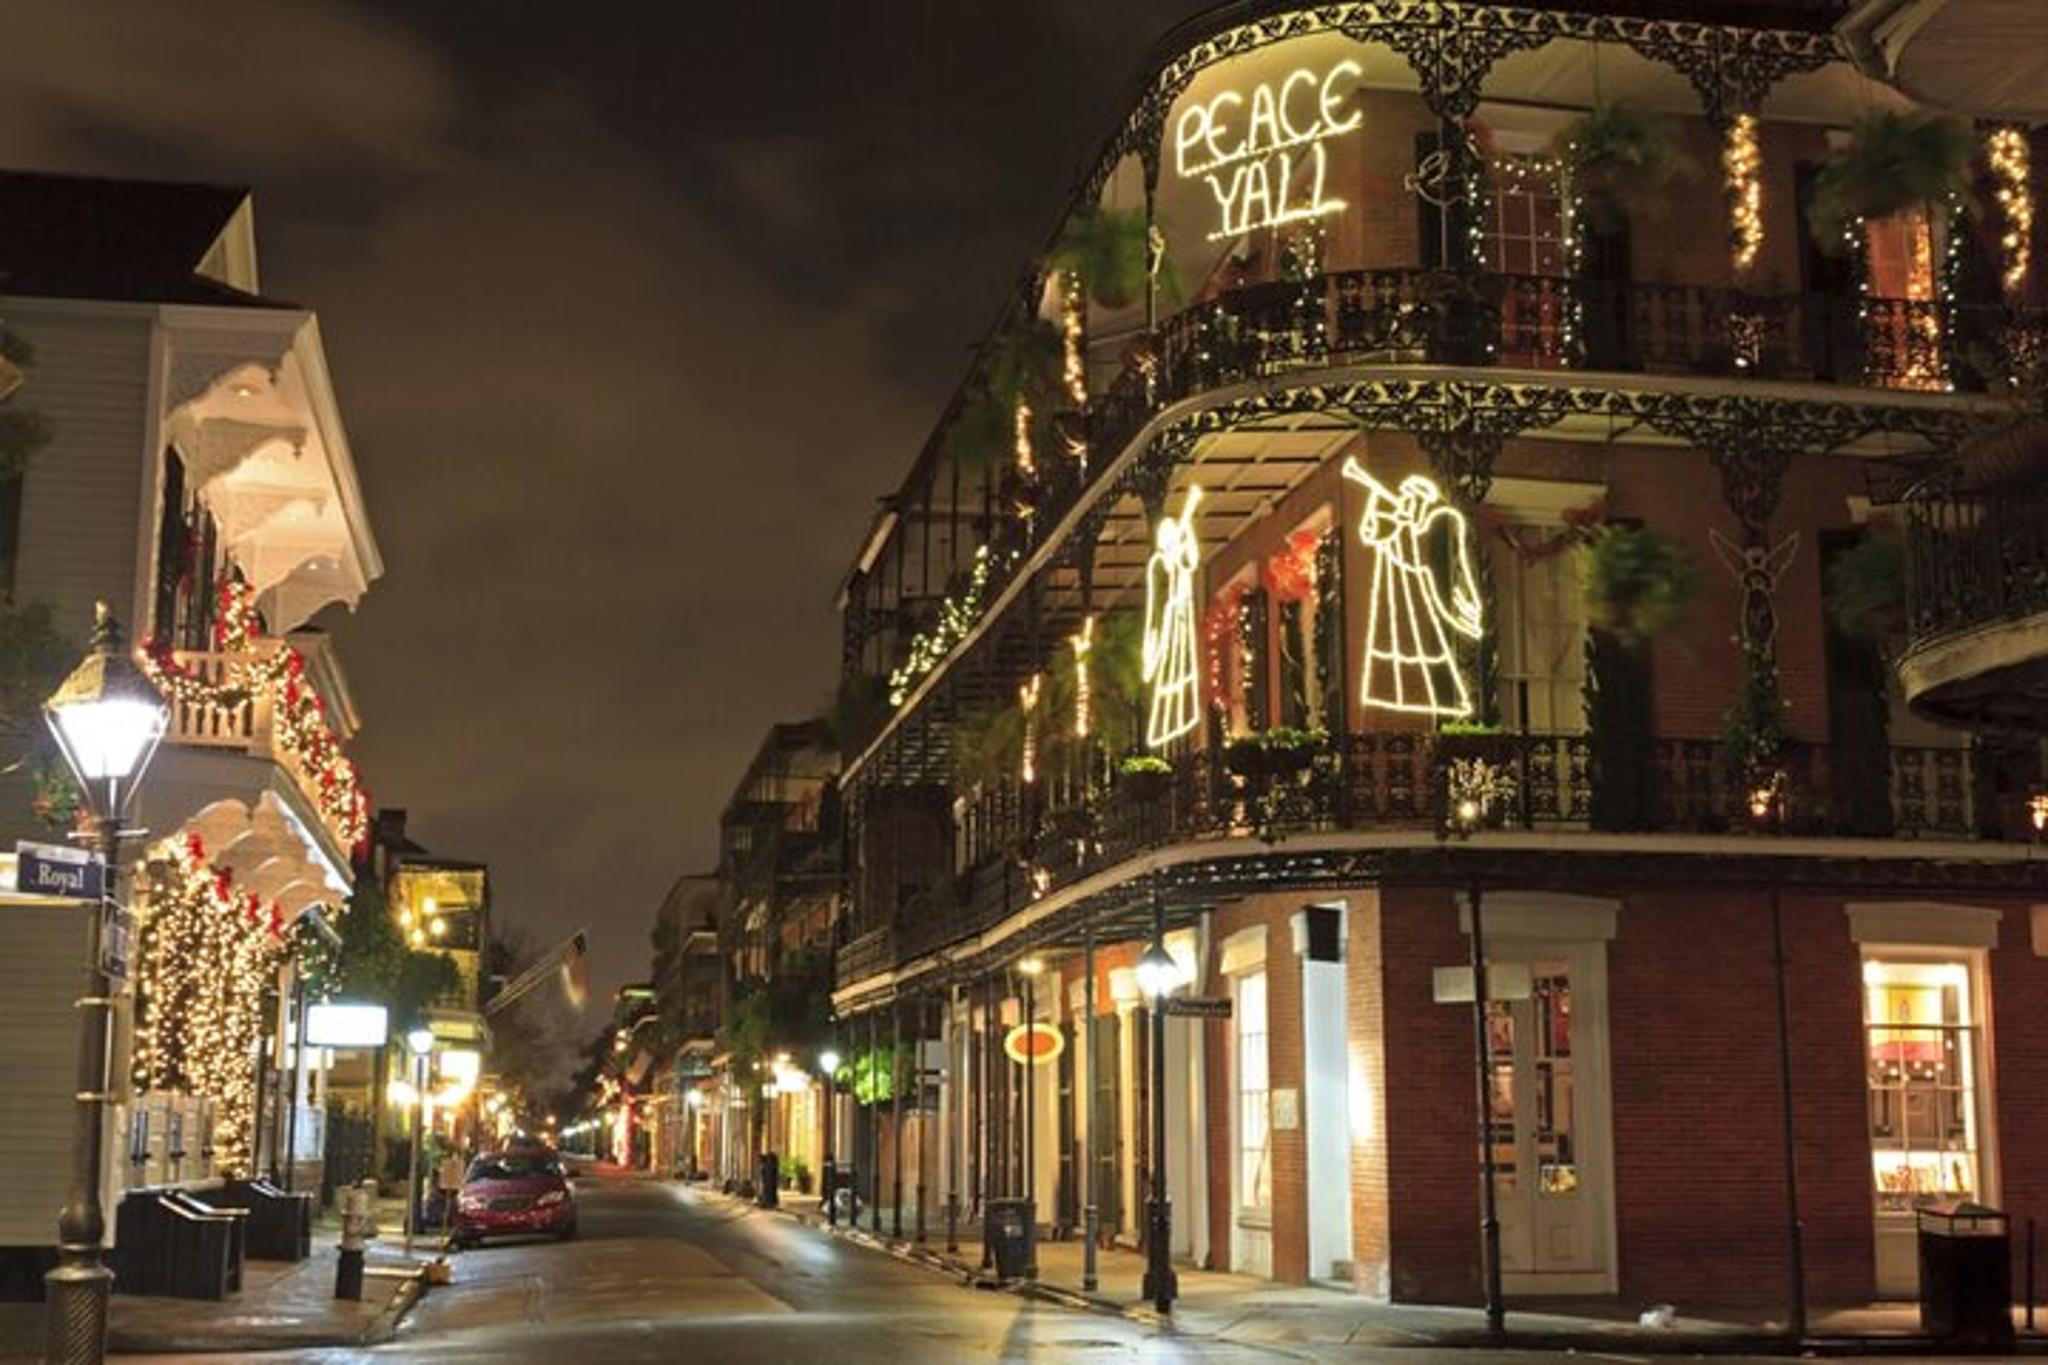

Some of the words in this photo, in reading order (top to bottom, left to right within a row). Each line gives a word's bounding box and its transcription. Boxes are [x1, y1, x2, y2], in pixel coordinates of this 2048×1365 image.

[1175, 59, 1363, 176] PEACE
[1204, 141, 1348, 237] YALL
[39, 863, 84, 895] Royal
